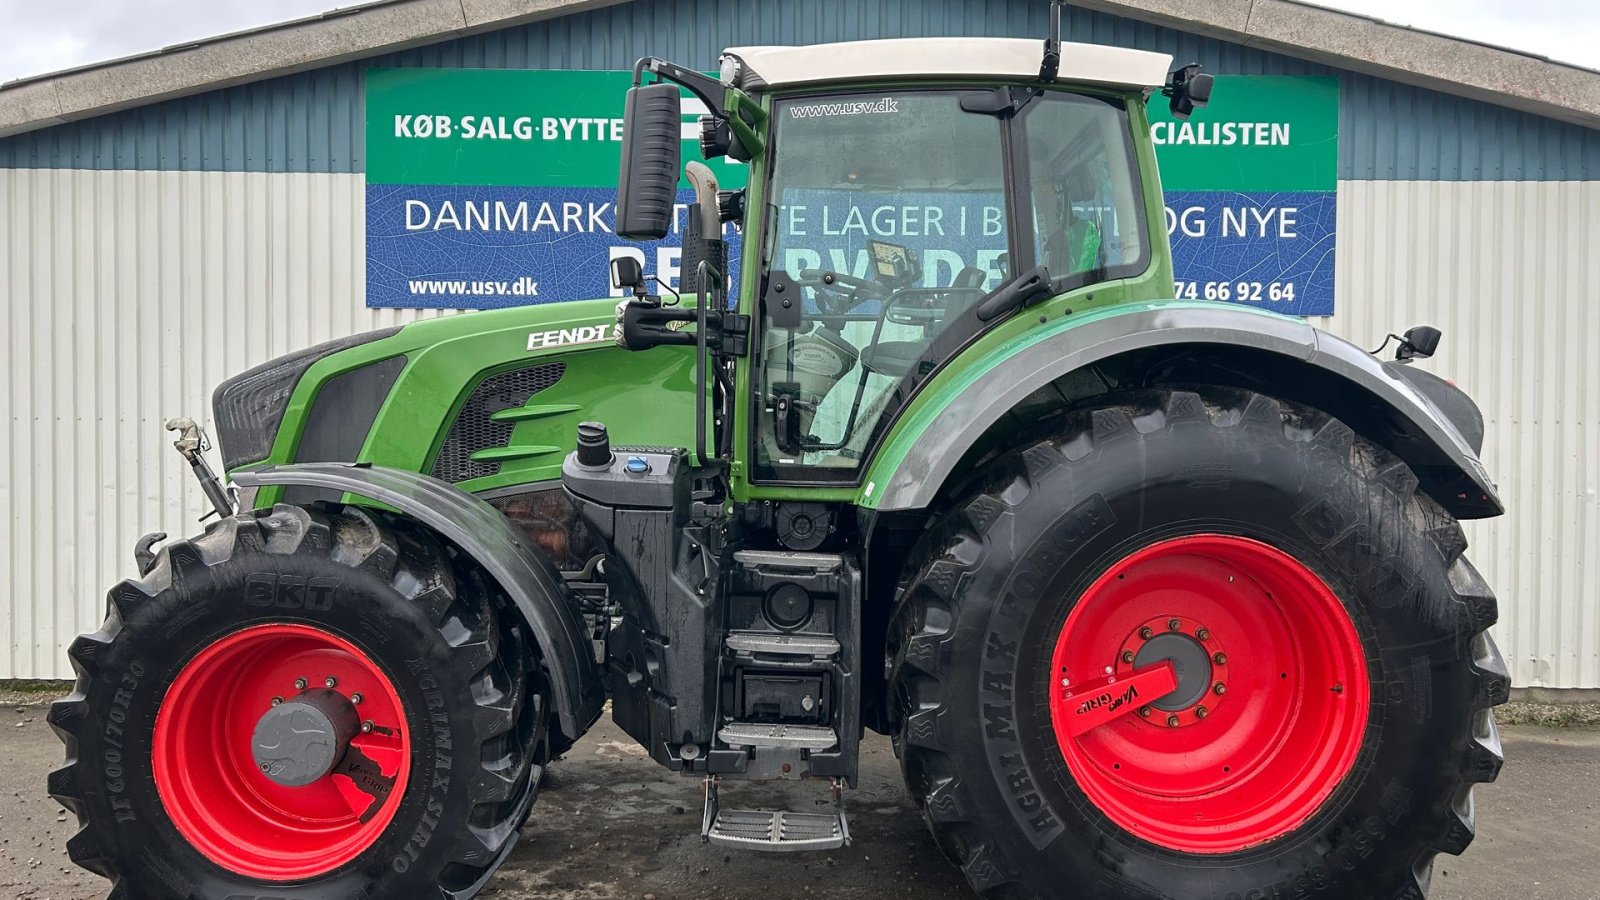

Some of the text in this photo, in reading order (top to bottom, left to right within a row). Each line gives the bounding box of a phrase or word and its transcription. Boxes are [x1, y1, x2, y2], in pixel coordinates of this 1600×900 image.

[790, 98, 898, 118] www.usv.dk
[1151, 122, 1290, 146] CIALISTEN
[405, 200, 617, 233] DANMARK
[823, 205, 945, 236] LAGER
[960, 206, 966, 236] I
[1222, 207, 1298, 238] NYE
[409, 277, 538, 296] www.usv.dk
[1174, 282, 1295, 301] 74 66 92 64
[526, 324, 611, 350] FENDT
[246, 574, 337, 610] BKT
